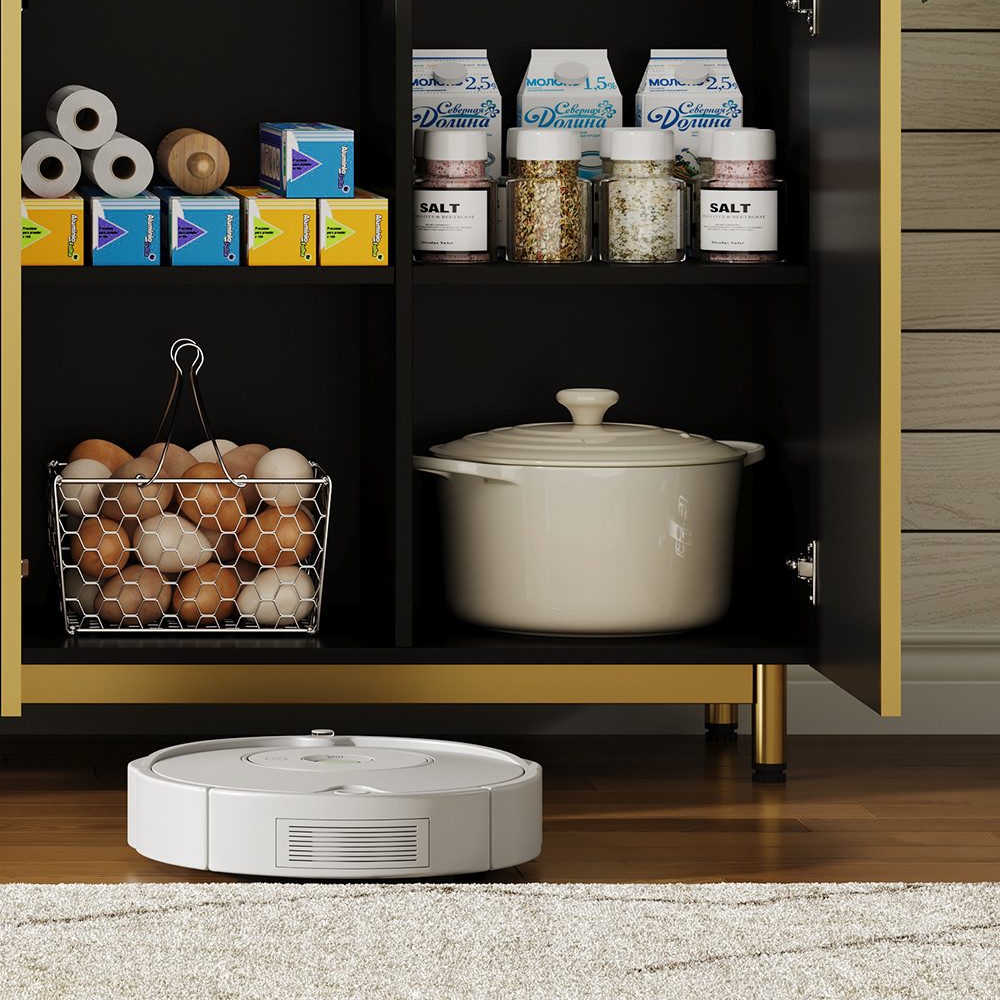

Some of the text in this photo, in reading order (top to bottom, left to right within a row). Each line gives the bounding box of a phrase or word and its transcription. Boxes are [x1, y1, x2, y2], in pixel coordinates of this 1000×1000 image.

[437, 101, 484, 115] Северная
[554, 101, 601, 116] Северная
[678, 101, 726, 115] Северная
[412, 106, 490, 128] Долина
[524, 106, 608, 129] Долина
[647, 106, 732, 132] Долина
[420, 202, 460, 213] SALT
[709, 202, 752, 213] SALT
